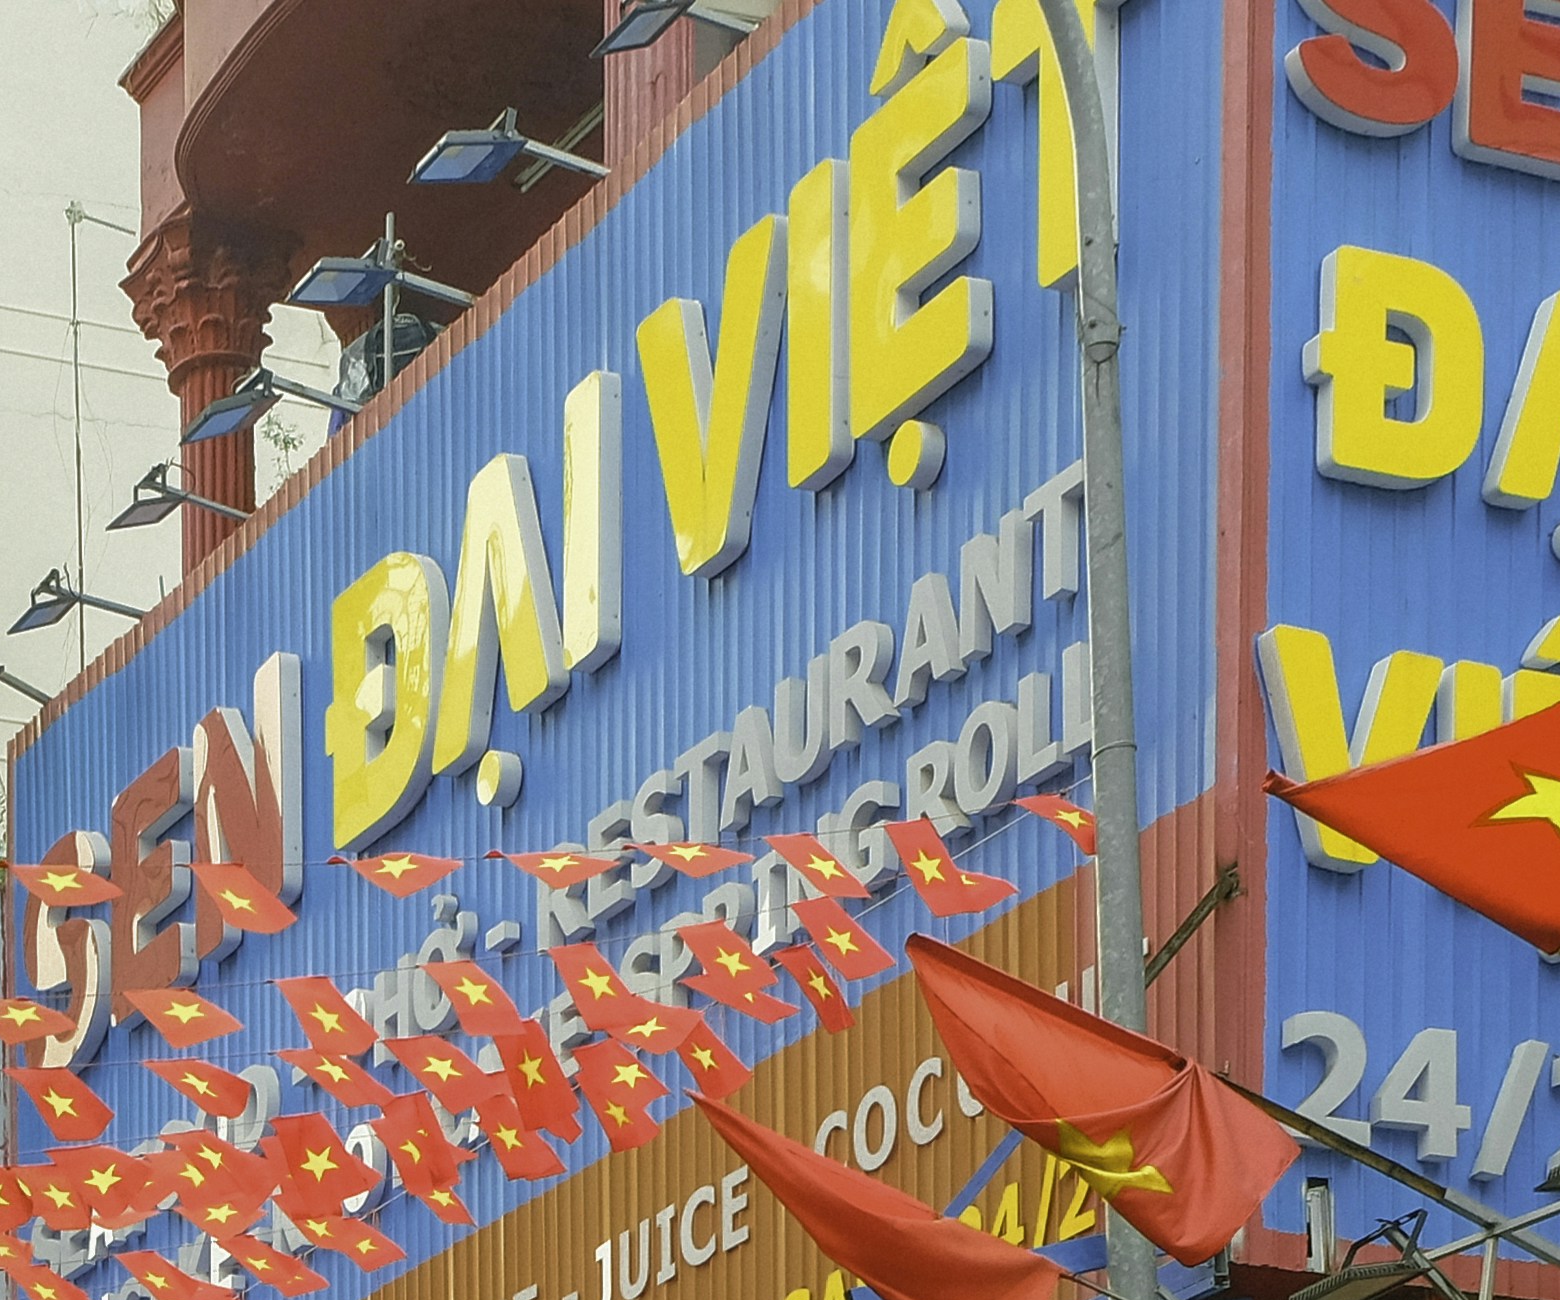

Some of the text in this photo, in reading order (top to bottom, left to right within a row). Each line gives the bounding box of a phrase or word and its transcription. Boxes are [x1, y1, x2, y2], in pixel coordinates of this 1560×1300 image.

[24, 652, 302, 1072] SEN
[325, 370, 622, 852] ĐẠI
[537, 460, 1084, 956] RESTAURANT
